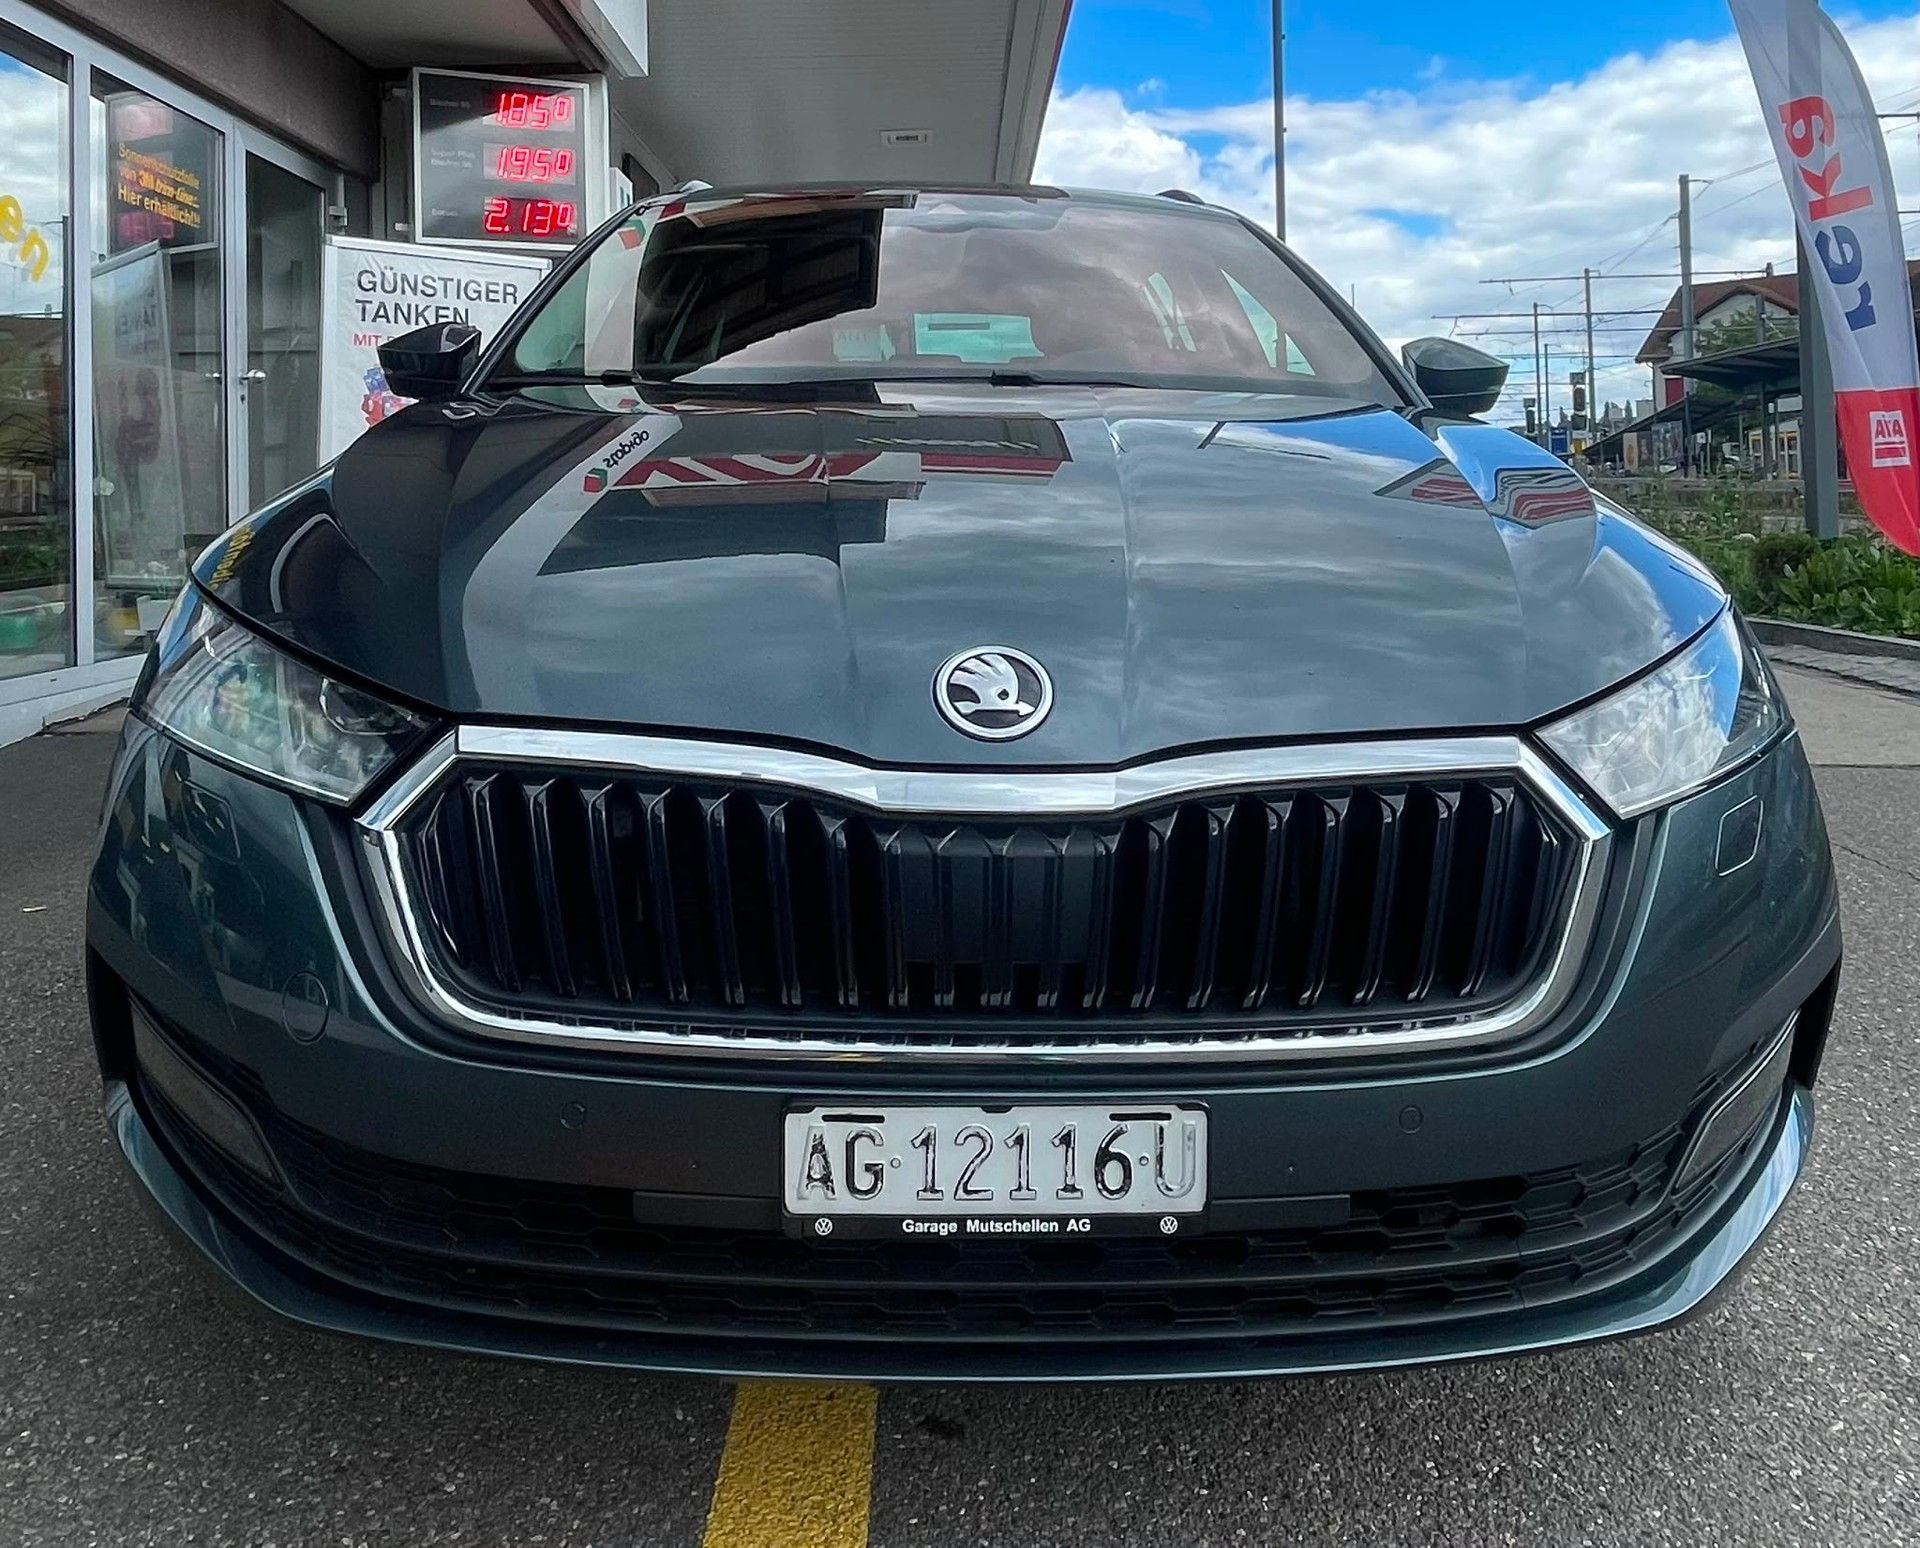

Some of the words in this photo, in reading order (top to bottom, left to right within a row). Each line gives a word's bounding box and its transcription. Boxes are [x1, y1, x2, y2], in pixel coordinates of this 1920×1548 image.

[118, 182, 142, 206] Hier
[356, 265, 518, 305] GÜNSTIGER
[355, 298, 470, 326] TANKEN
[353, 333, 382, 347] MIT
[902, 1219, 958, 1236] Garage
[966, 1219, 1059, 1233] Mutschellen
[1066, 1218, 1091, 1232] AG
